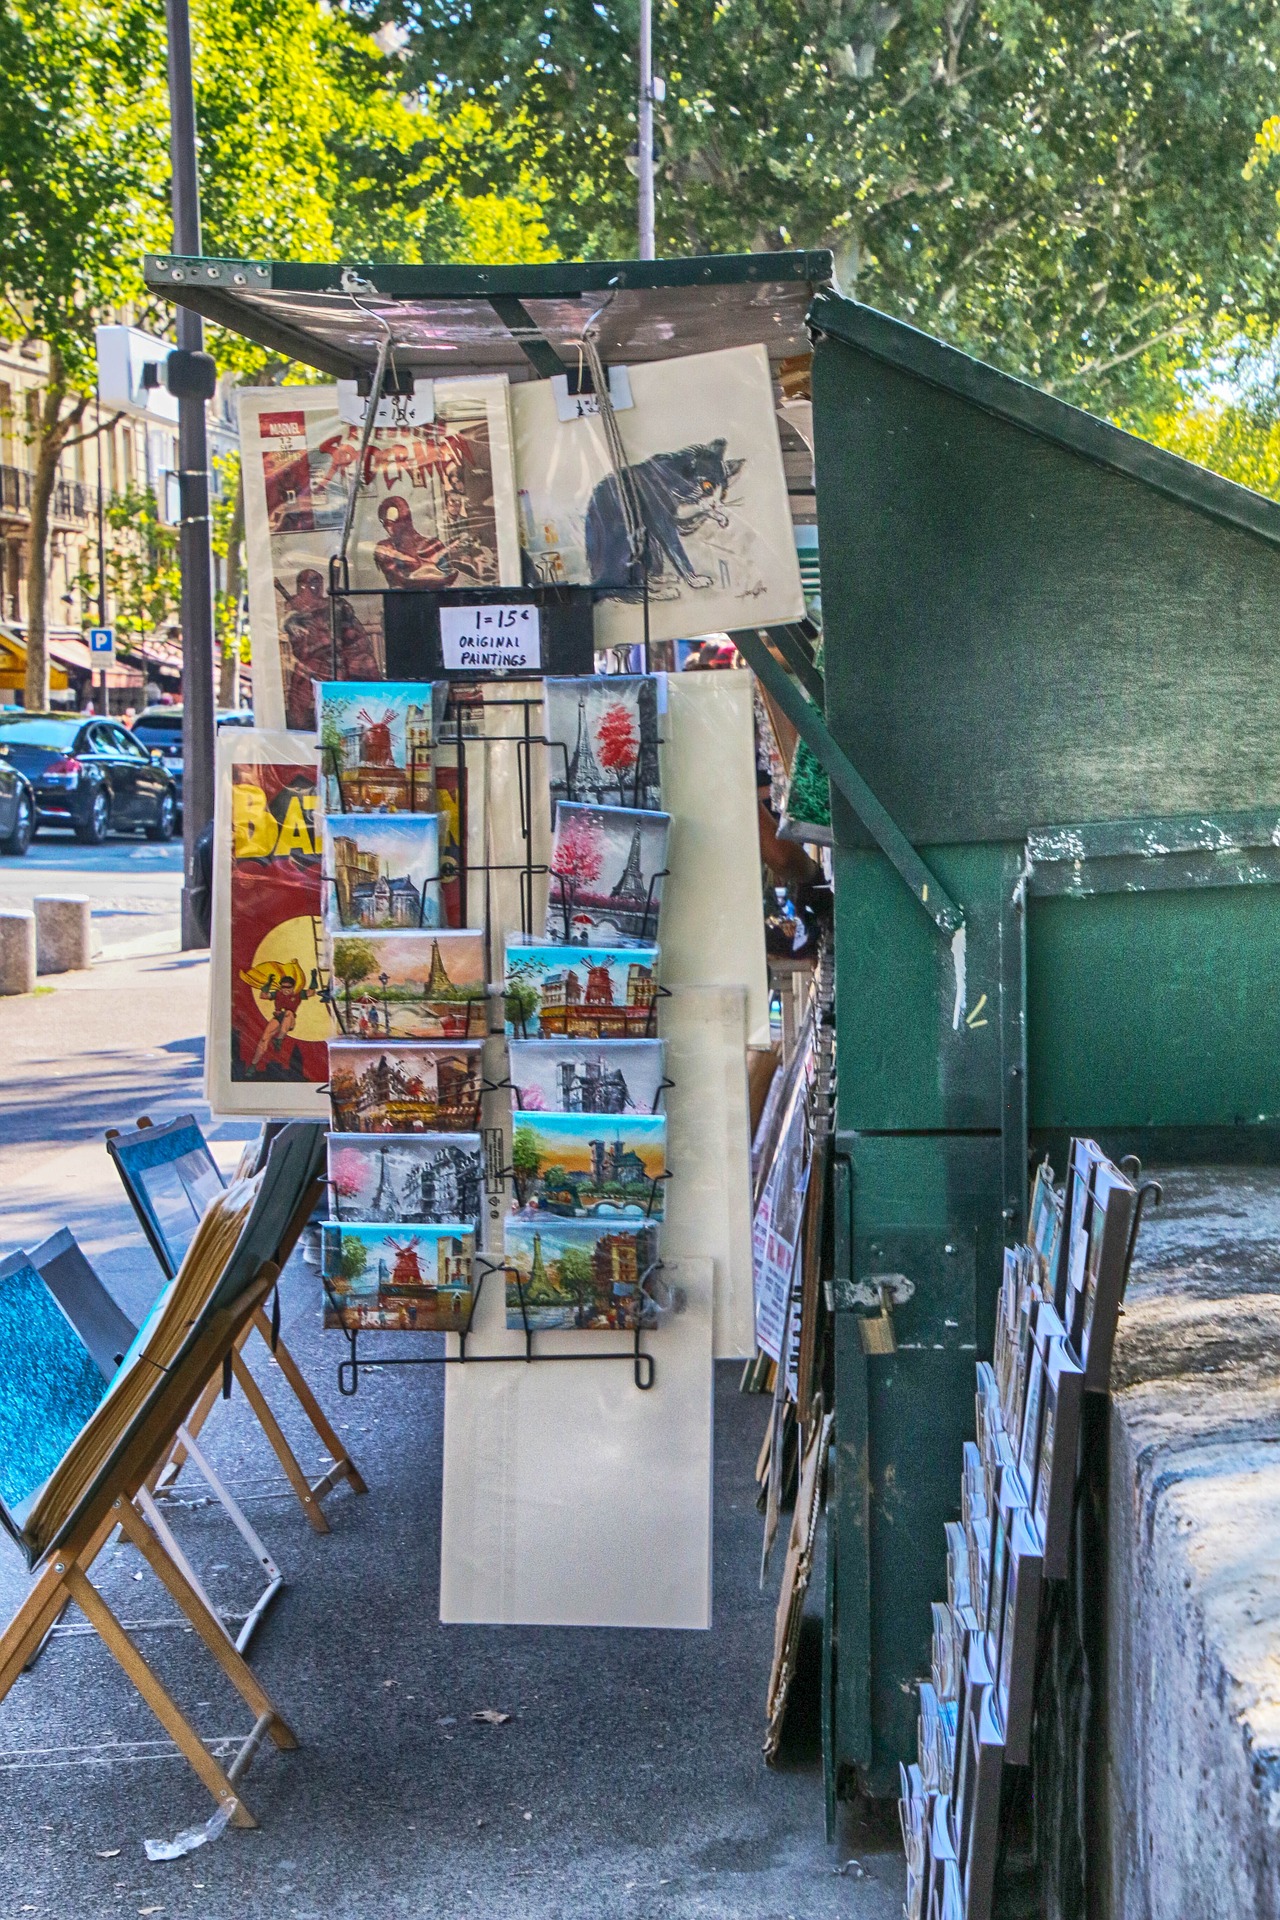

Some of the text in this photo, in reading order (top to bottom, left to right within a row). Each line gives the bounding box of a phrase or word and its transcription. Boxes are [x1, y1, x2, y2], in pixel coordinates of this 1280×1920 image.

[270, 423, 300, 436] MARVEL
[95, 633, 108, 648] P
[459, 634, 520, 648] ORIGINAL
[461, 651, 527, 667] PAINTINGS
